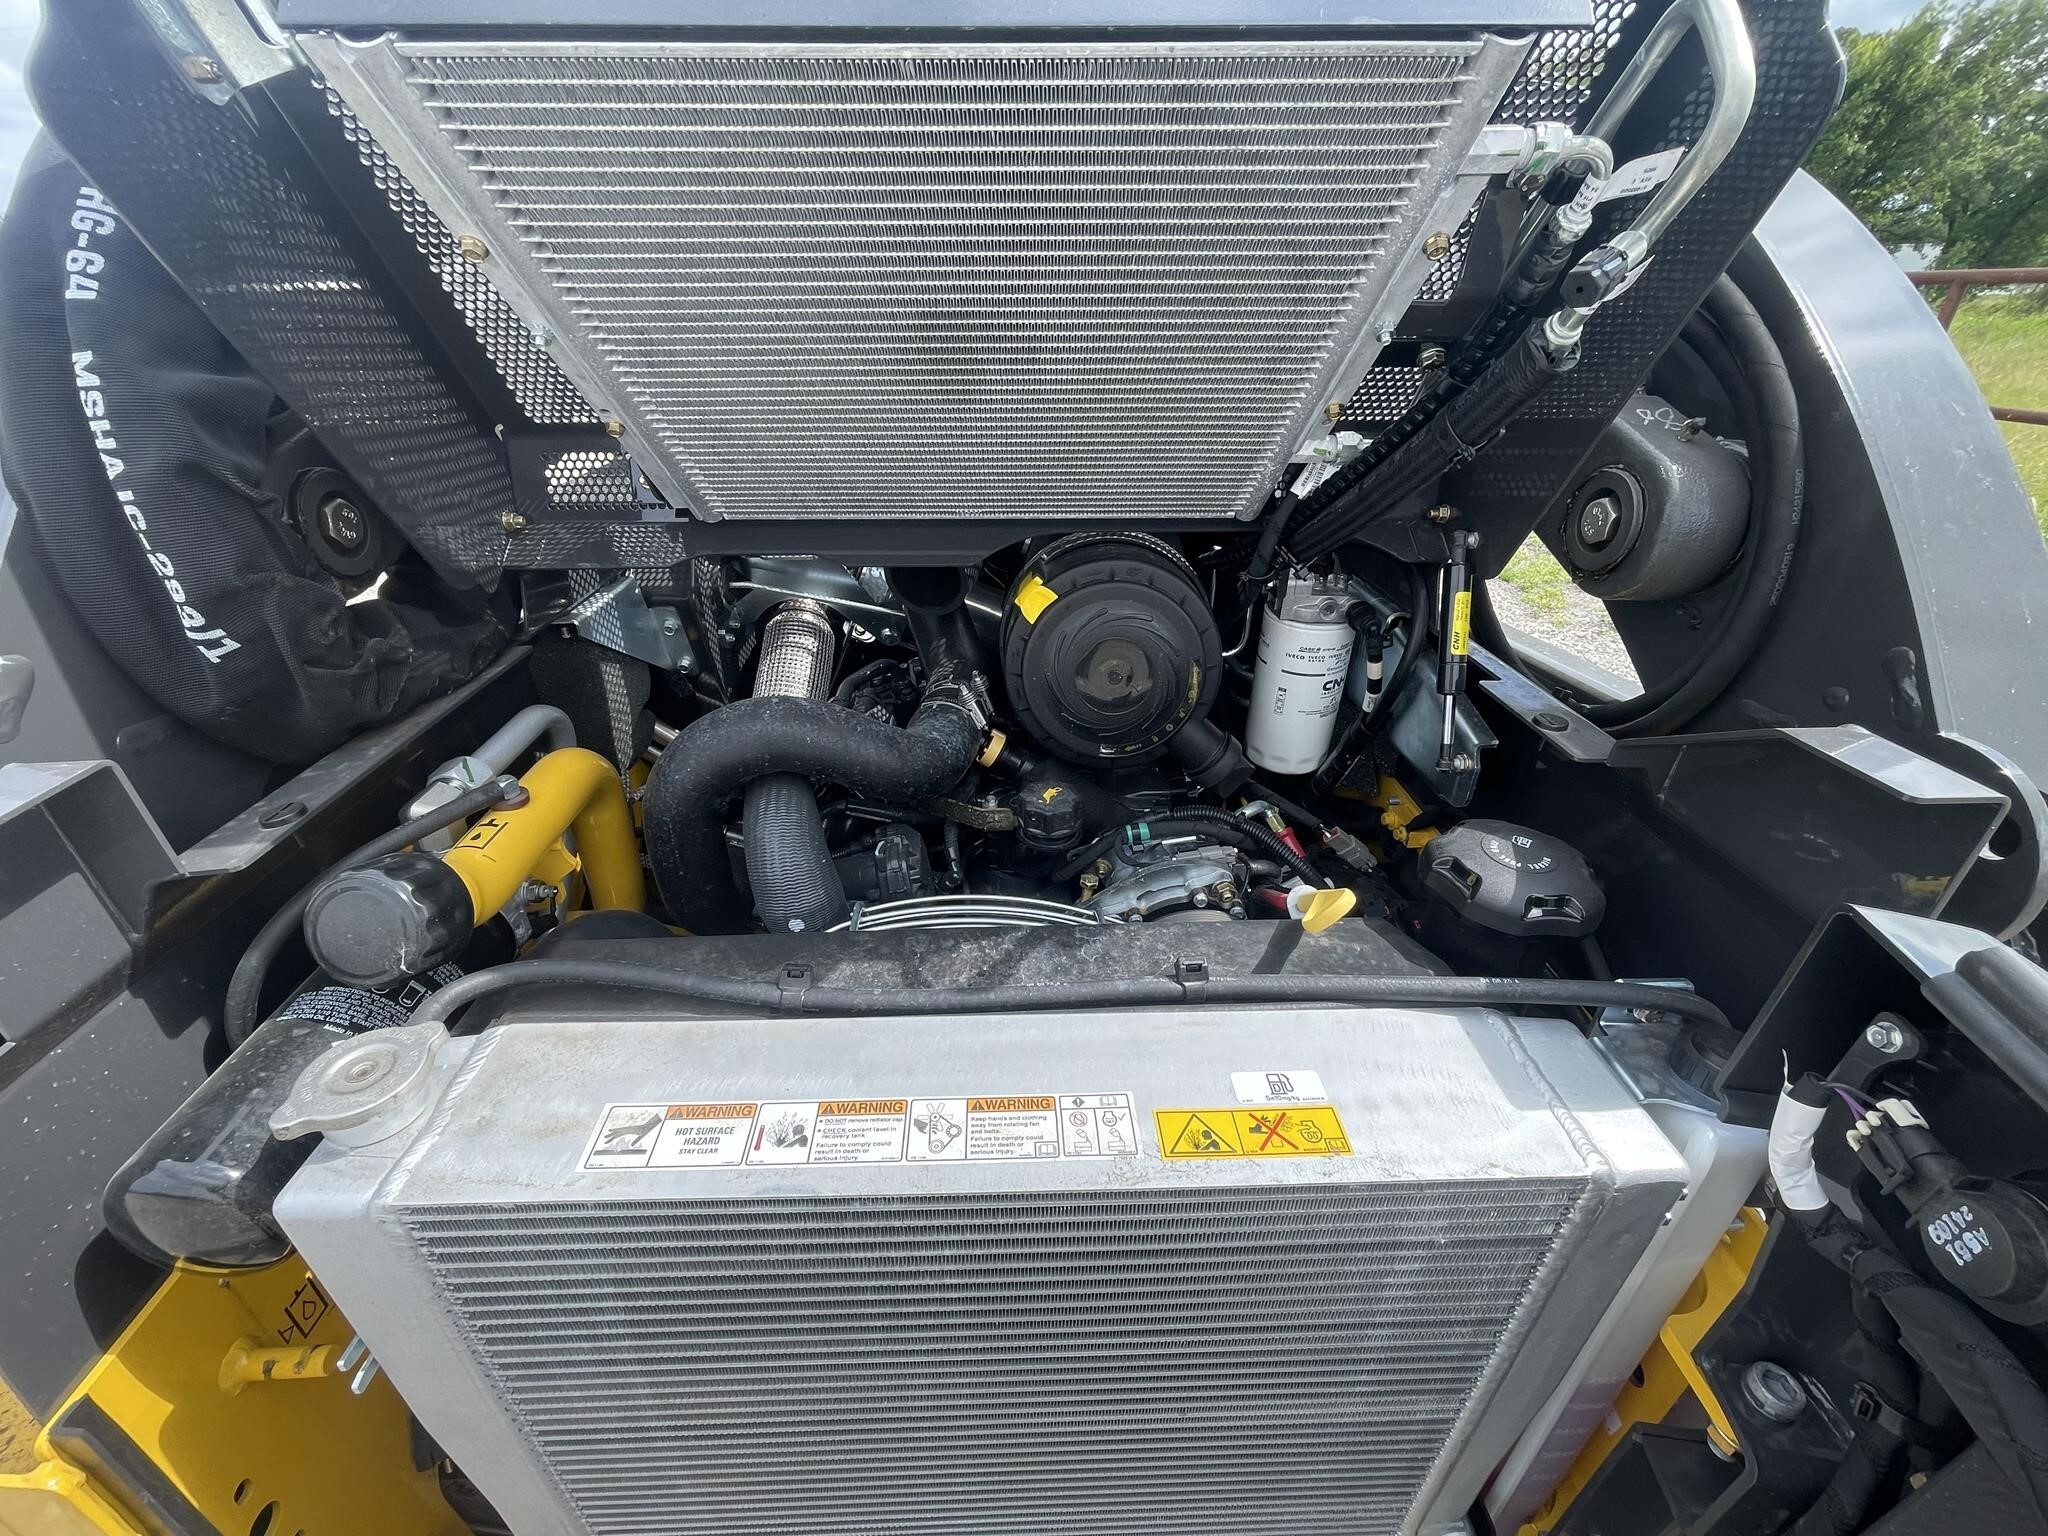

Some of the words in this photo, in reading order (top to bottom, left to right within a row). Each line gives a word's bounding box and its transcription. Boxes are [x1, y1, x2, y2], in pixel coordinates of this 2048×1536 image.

[72, 350, 125, 480] MSHA
[1452, 631, 1461, 650] CNH
[1285, 652, 1305, 660] IVECO
[371, 993, 380, 1001] TO
[323, 1023, 345, 1034] Made
[345, 1029, 354, 1037] in
[836, 1101, 904, 1114] WARNING
[984, 1098, 1051, 1110] WARNING
[686, 1105, 753, 1118] WARNING
[675, 1127, 695, 1136] HOT
[695, 1126, 736, 1136] SURFACE
[683, 1137, 721, 1146] HAZARD
[847, 1141, 871, 1149] comply
[1928, 1205, 1974, 1245] 24109
